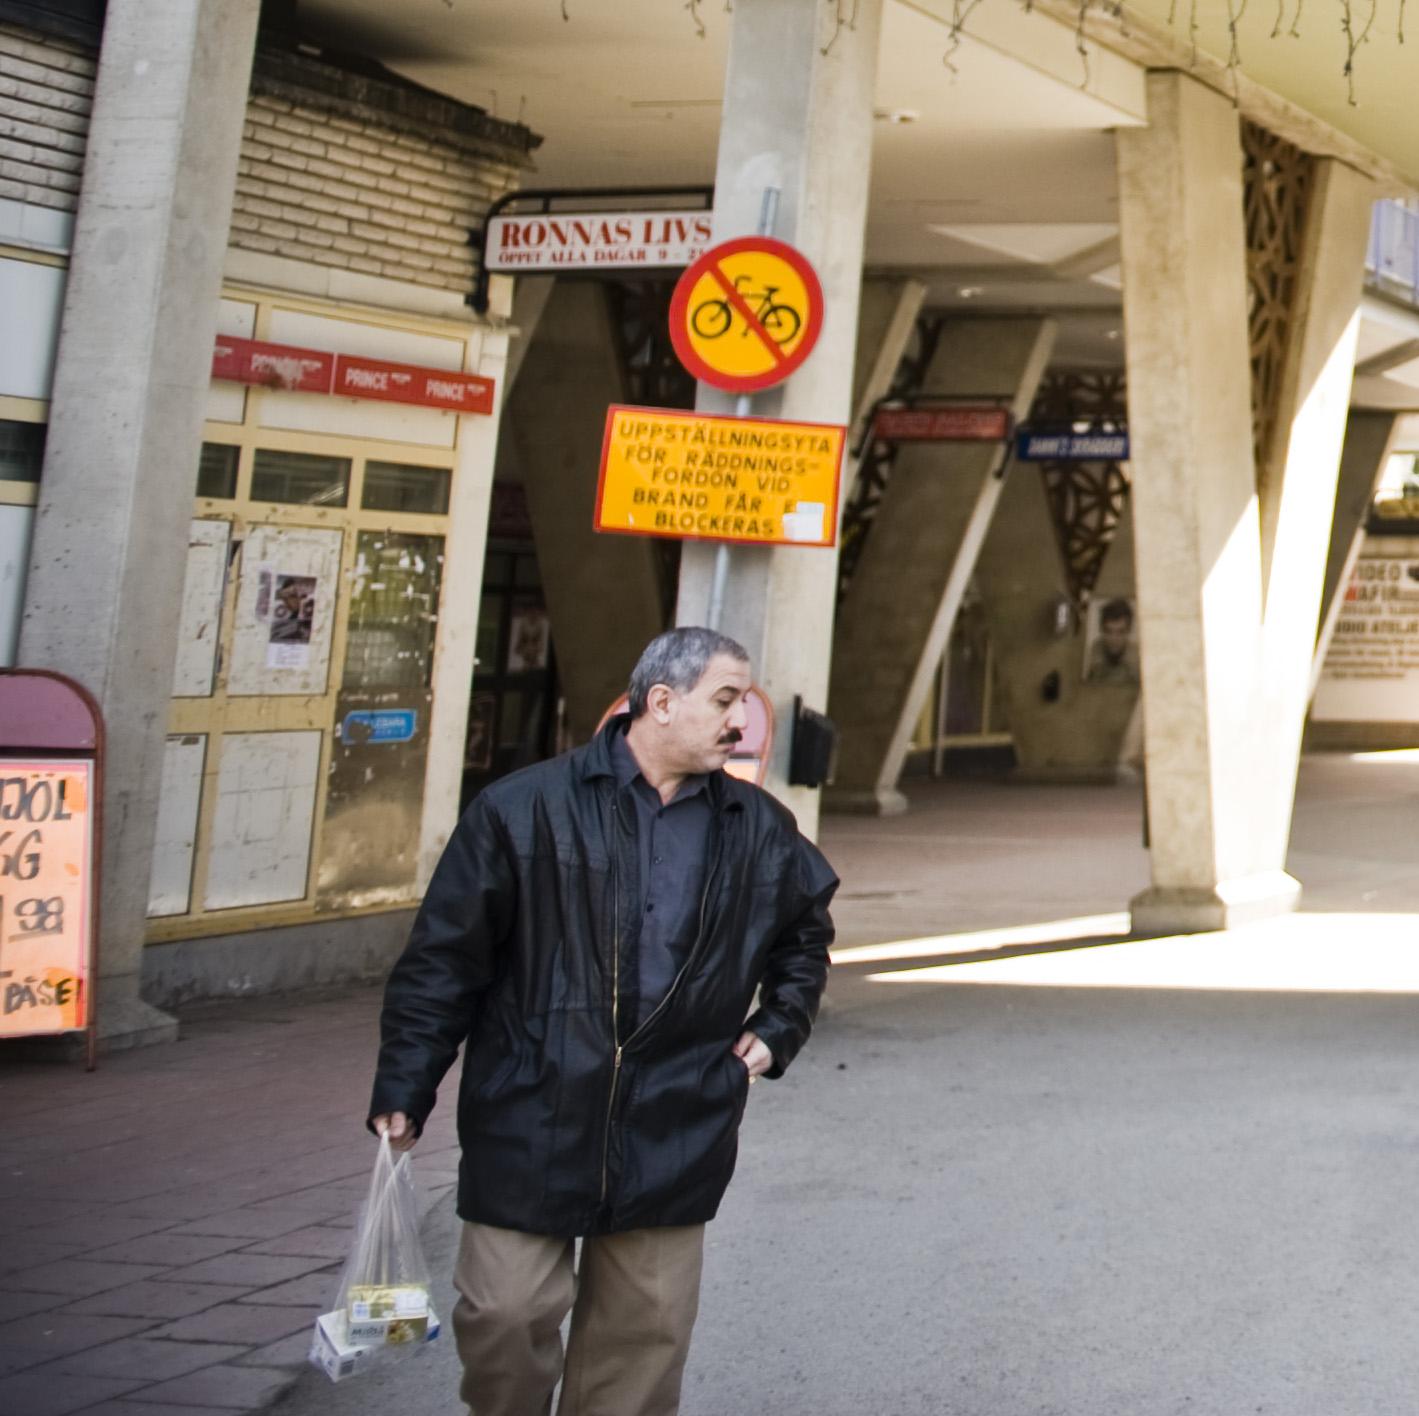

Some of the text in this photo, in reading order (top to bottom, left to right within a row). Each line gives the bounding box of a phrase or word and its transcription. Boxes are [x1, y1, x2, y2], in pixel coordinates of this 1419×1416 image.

[500, 217, 711, 248] RONNAS LIVS
[550, 250, 587, 263] ALLA
[594, 248, 647, 263] DAGAR
[345, 367, 388, 391] PRINCE
[425, 379, 464, 401] PRINCE
[619, 420, 830, 453] UPPSTÄLLNINGSYTA
[625, 445, 667, 464] FÖR
[651, 467, 790, 492] FORDON VID
[633, 488, 708, 507] BRAND
[725, 492, 762, 513] FÅR
[654, 512, 774, 535] BLOCKERAS
[0, 773, 72, 823] JÖL
